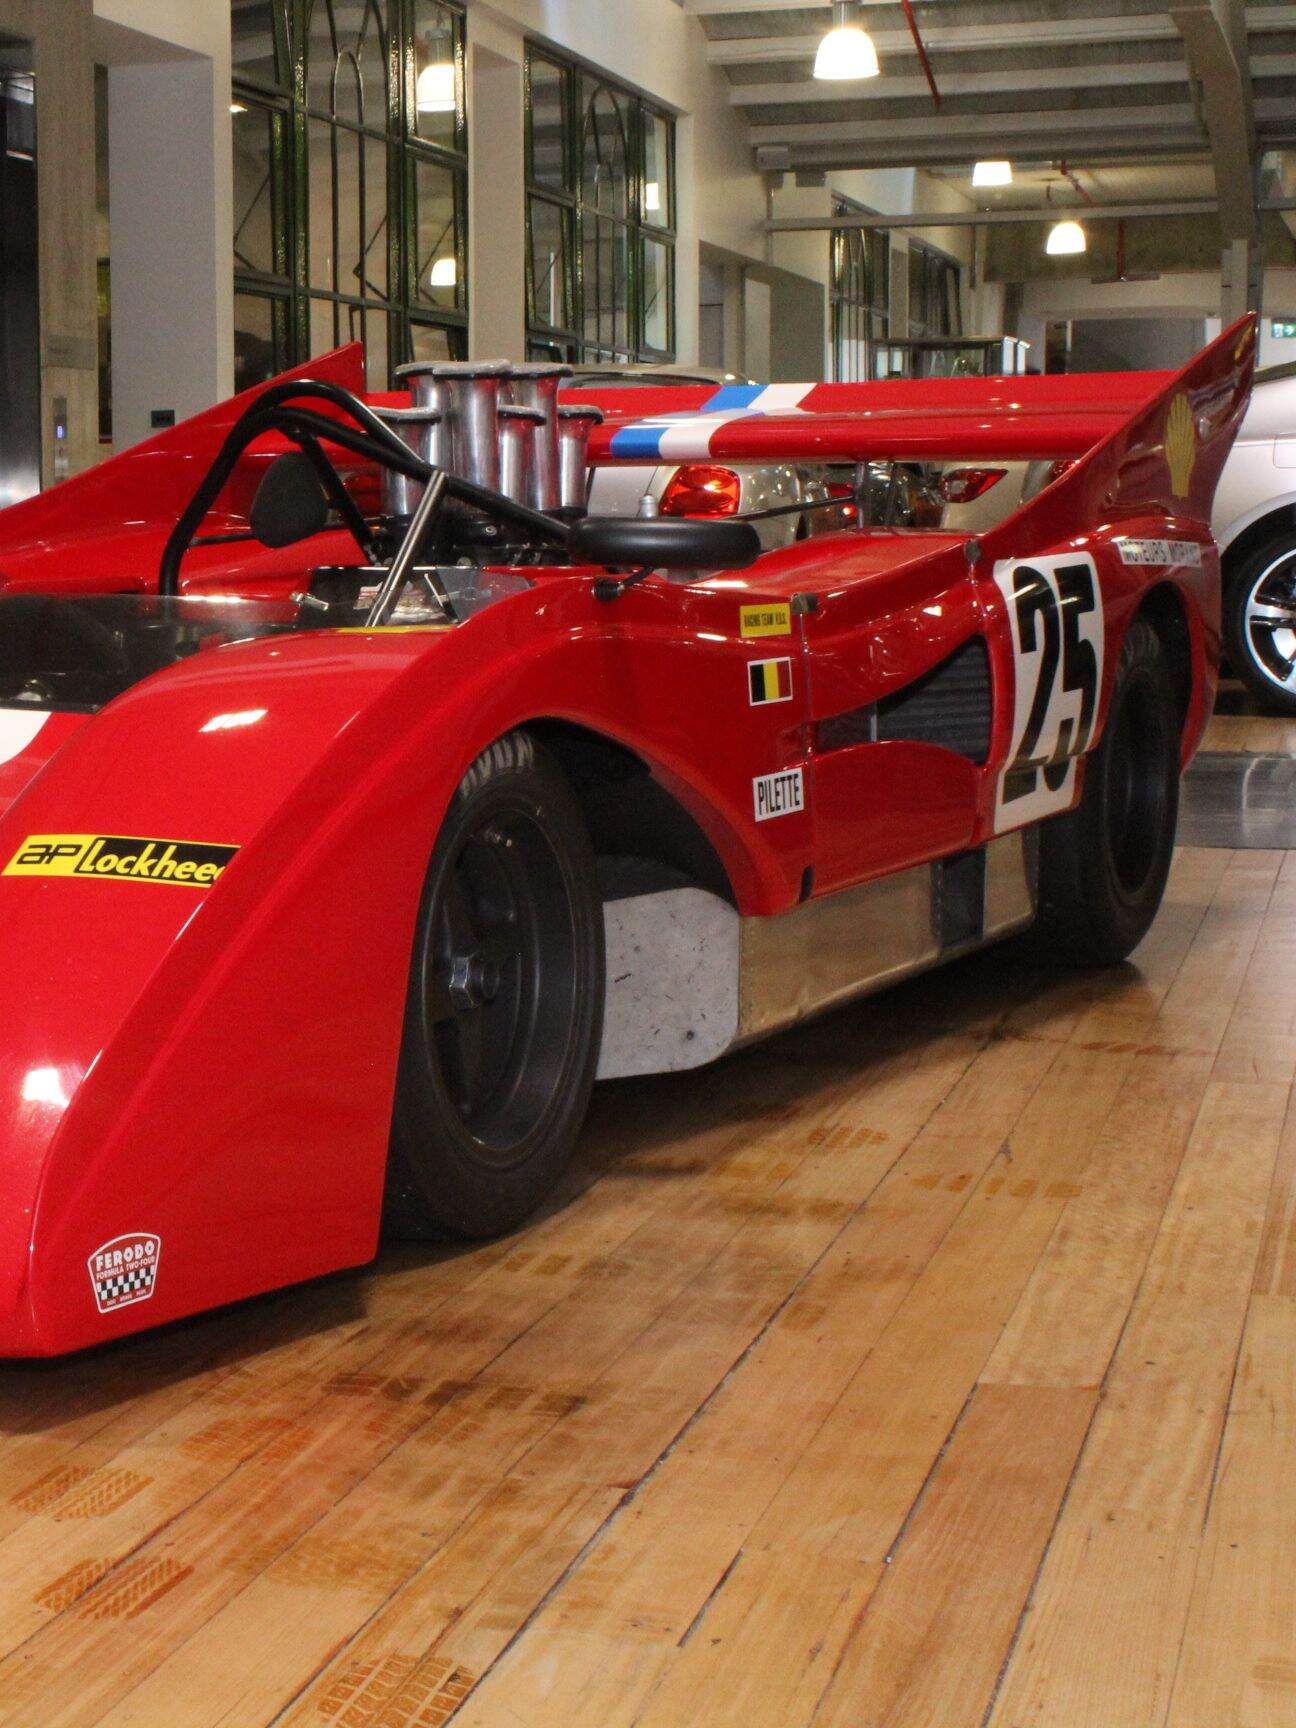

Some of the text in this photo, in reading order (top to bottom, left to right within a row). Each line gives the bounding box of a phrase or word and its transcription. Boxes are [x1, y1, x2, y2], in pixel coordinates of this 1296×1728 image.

[1002, 563, 1098, 805] 25
[757, 773, 800, 816] PILETTE
[95, 1240, 155, 1272] FERODO
[96, 1255, 156, 1280] FORMULA TWO-FOUR
